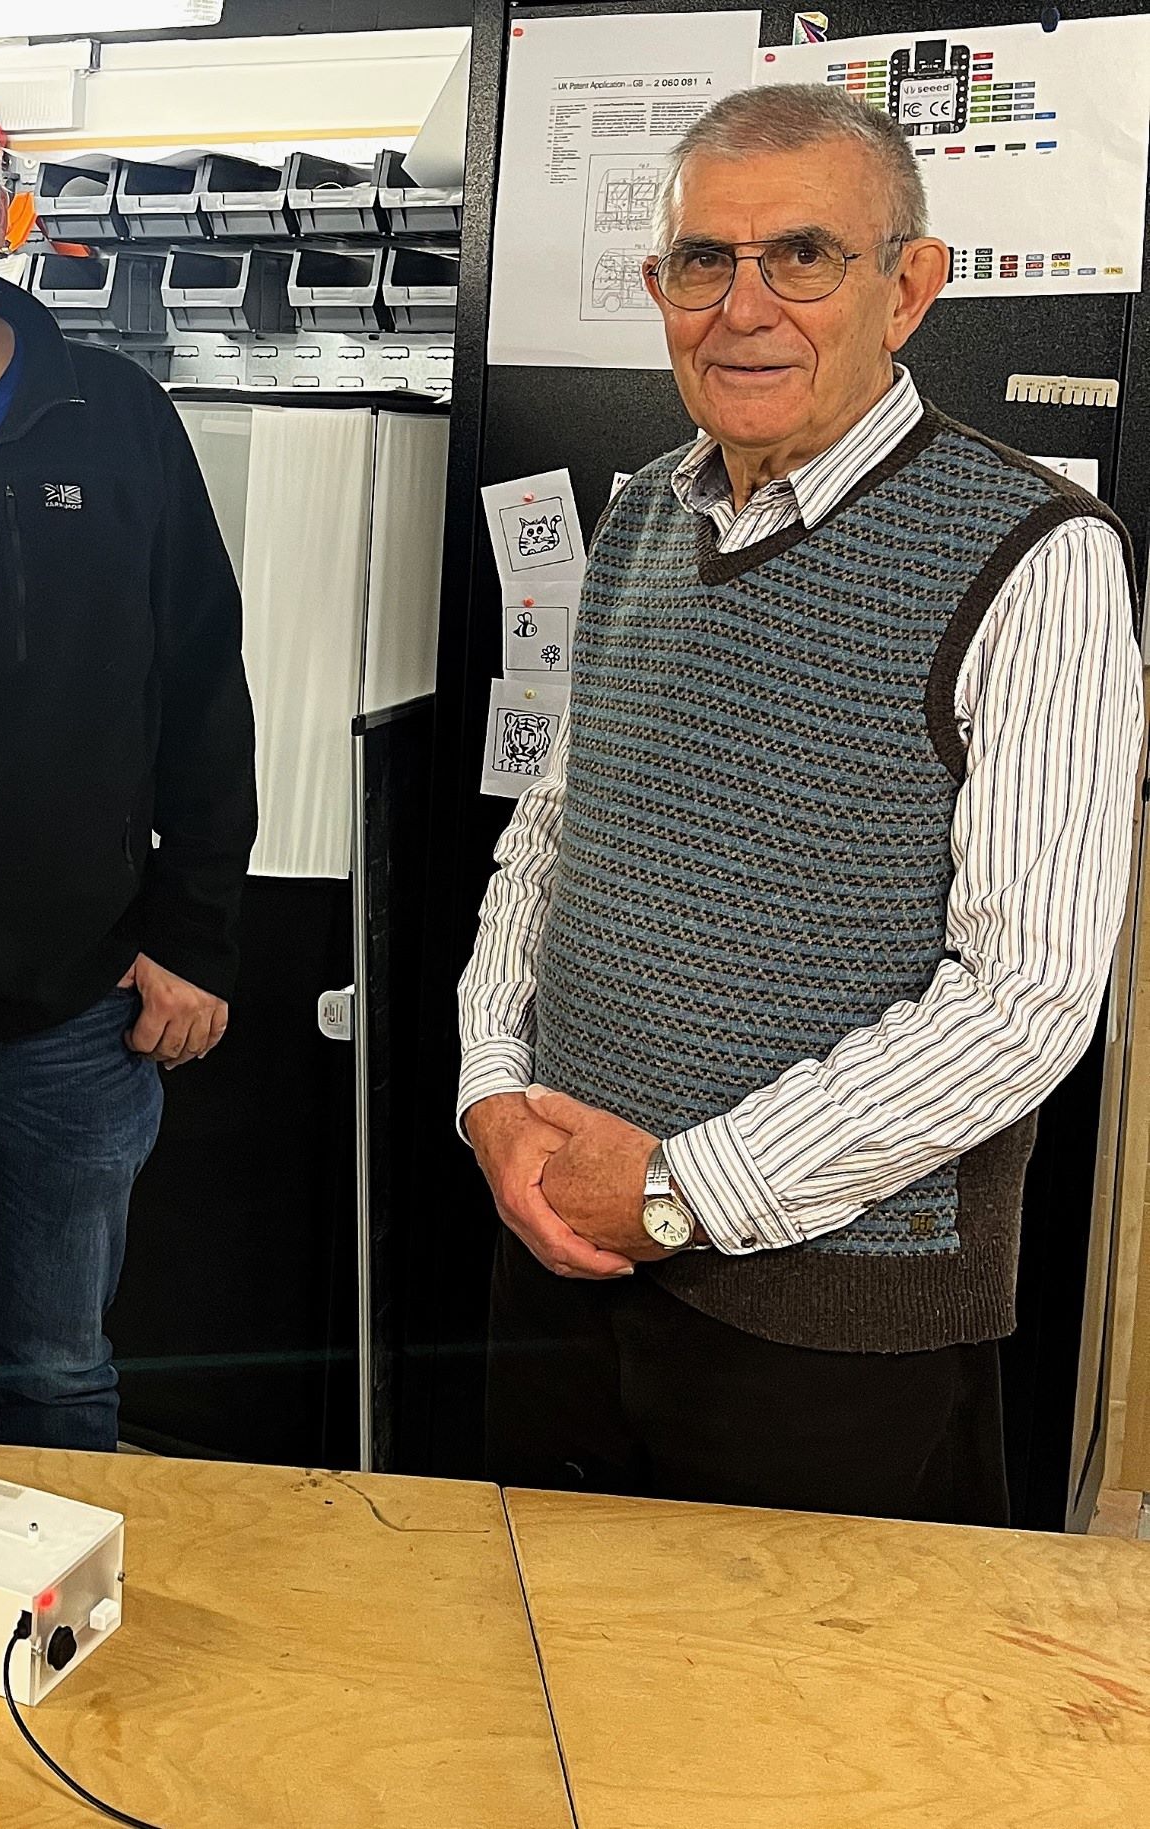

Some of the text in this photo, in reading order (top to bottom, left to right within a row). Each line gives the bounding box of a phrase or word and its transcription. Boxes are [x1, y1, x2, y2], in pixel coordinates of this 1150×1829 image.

[632, 79, 644, 88] GB
[653, 79, 660, 87] 2
[661, 79, 679, 87] 060
[705, 77, 712, 86] A
[917, 84, 949, 93] seeed
